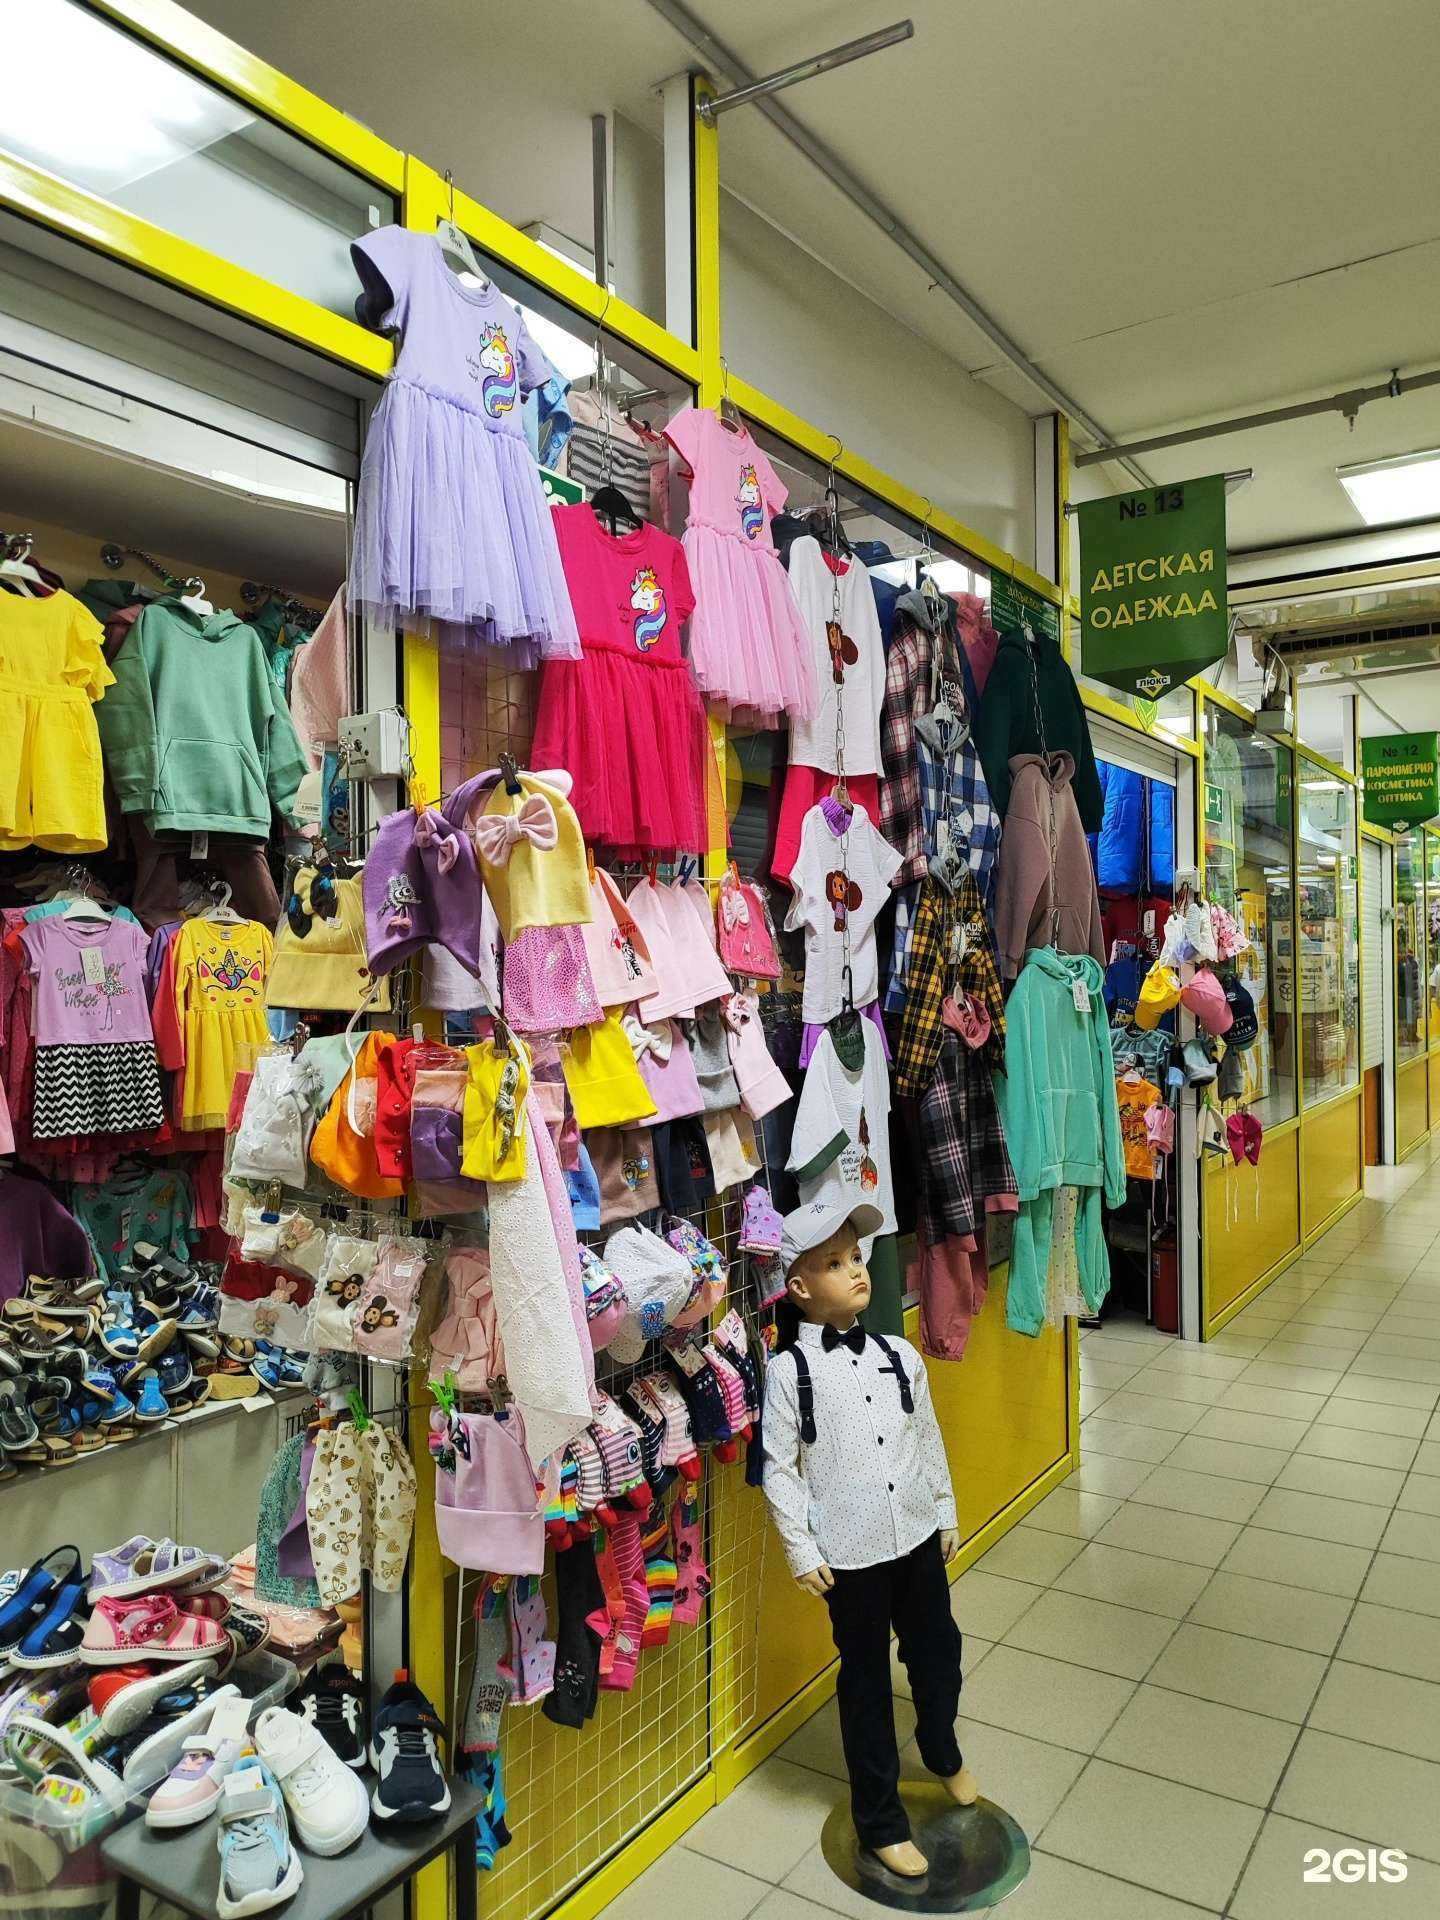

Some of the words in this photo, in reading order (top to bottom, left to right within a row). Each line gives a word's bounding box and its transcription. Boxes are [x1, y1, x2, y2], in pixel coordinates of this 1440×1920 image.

[1155, 488, 1183, 511] 13
[1090, 550, 1214, 594] ДЕТСКАЯ
[1090, 589, 1218, 629] ОДЕЖДА
[1404, 745, 1419, 756] 12
[1366, 762, 1434, 778] ПАРФЮМЕРИЯ
[1366, 777, 1434, 791] КОСМЕТИКА
[1377, 791, 1423, 804] ОПТИКА
